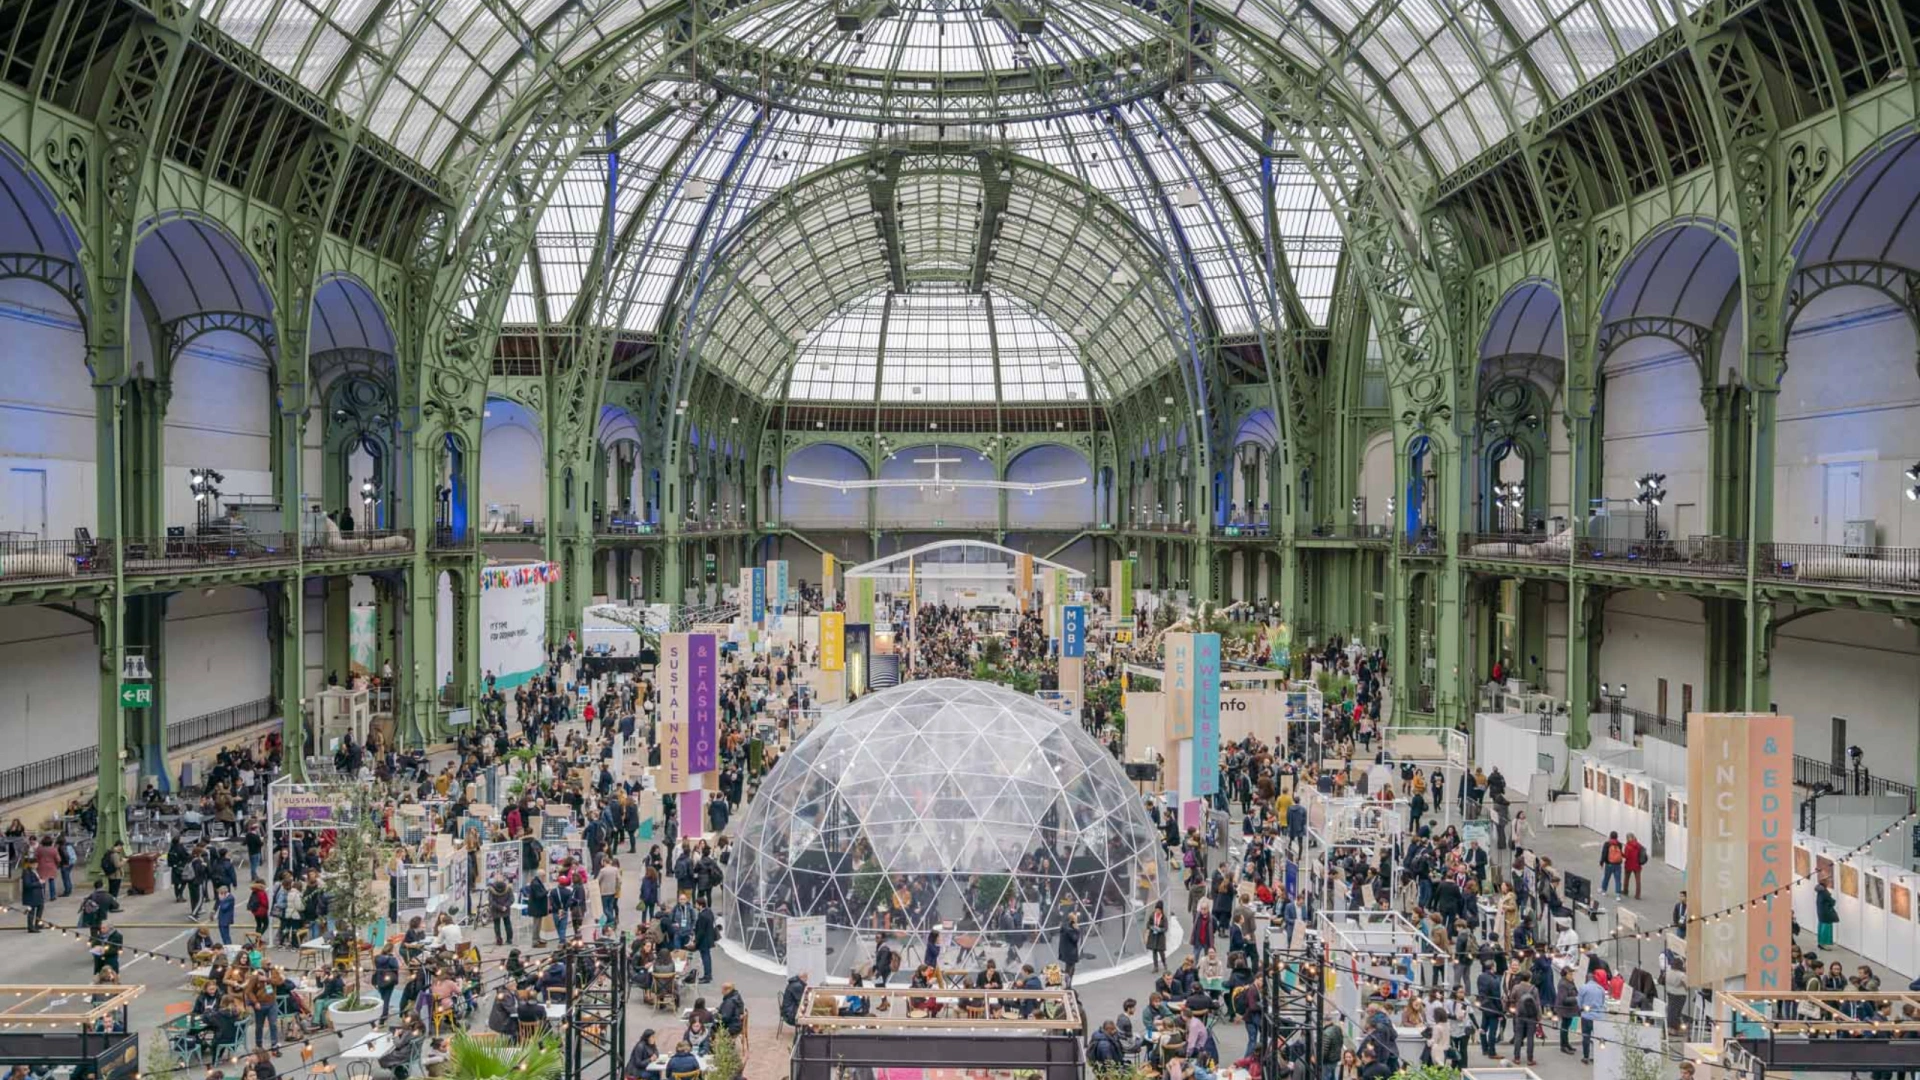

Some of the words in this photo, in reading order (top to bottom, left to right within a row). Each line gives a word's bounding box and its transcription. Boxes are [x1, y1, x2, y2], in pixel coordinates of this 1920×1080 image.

[697, 645, 707, 658] &
[1066, 610, 1077, 655] MOBI
[669, 646, 679, 784] SUSTAINABLE
[697, 665, 708, 767] FASHION
[1175, 647, 1187, 733] HEAH
[1200, 663, 1214, 792] WELLBEING
[1220, 697, 1246, 712] nfo
[1763, 736, 1778, 755] &
[1715, 739, 1735, 969] INCLUSION
[1760, 770, 1779, 989] EDUCATION
